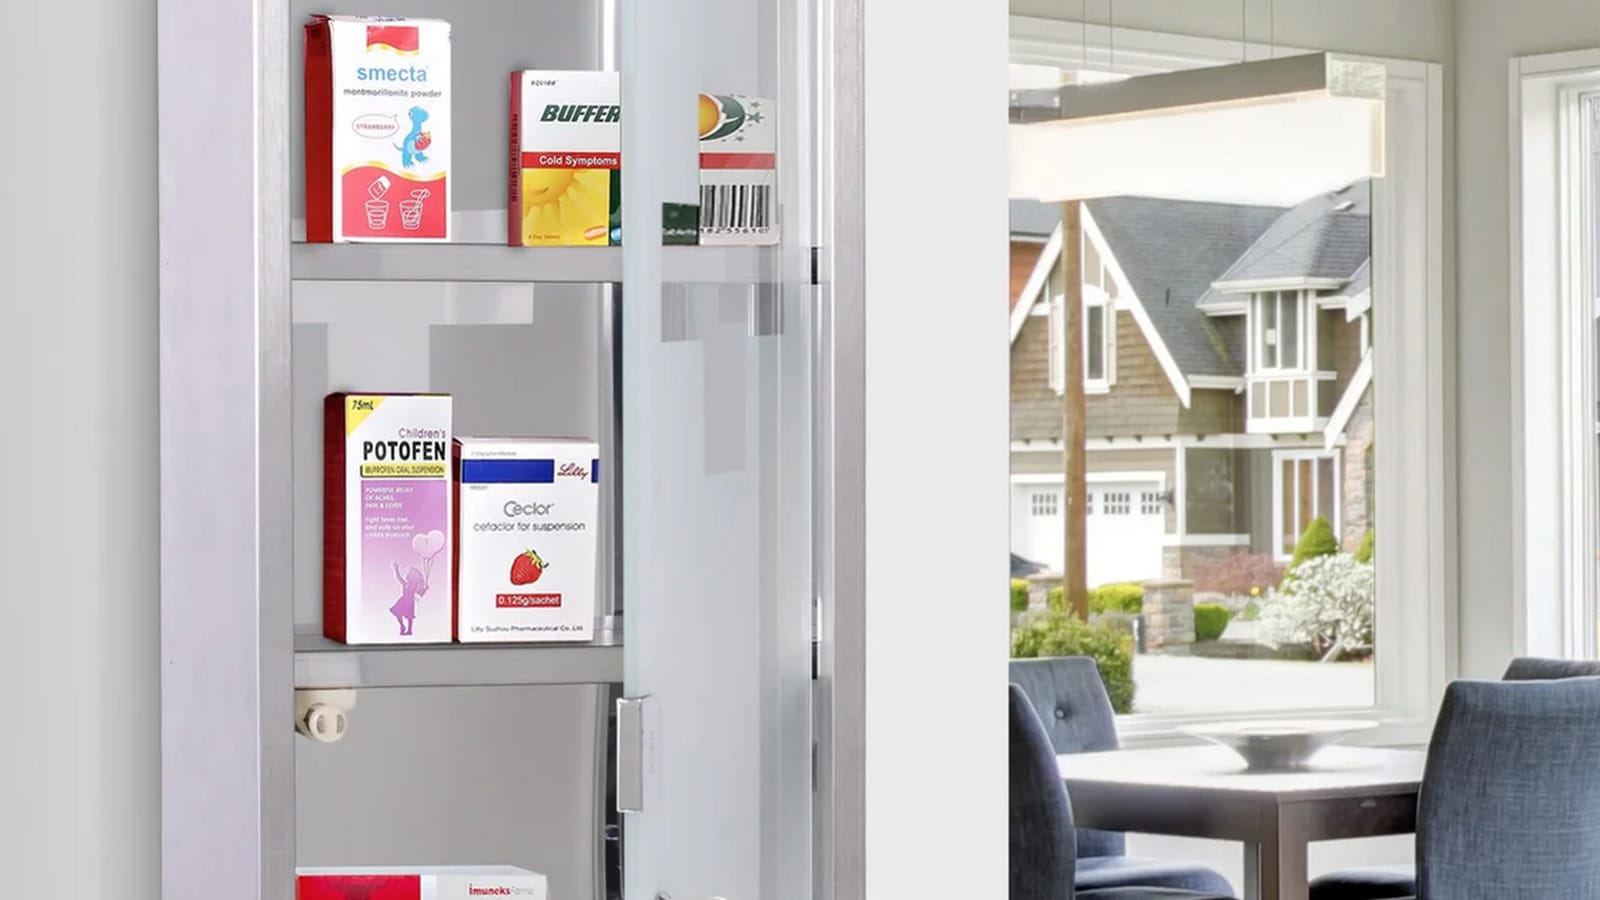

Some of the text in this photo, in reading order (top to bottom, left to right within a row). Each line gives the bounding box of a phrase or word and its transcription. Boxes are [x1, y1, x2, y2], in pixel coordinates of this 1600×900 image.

[357, 66, 427, 82] smecta
[343, 88, 442, 98] montmorillonite powder
[540, 104, 620, 122] BUFFER
[539, 155, 618, 168] Cold Symptoms
[352, 399, 374, 411] 75mL
[398, 428, 446, 439] Children's
[363, 441, 446, 461] POTOFEN
[557, 462, 589, 480] Lilly
[503, 501, 550, 518] Ceclor
[517, 521, 530, 532] for
[532, 522, 586, 533] suspension
